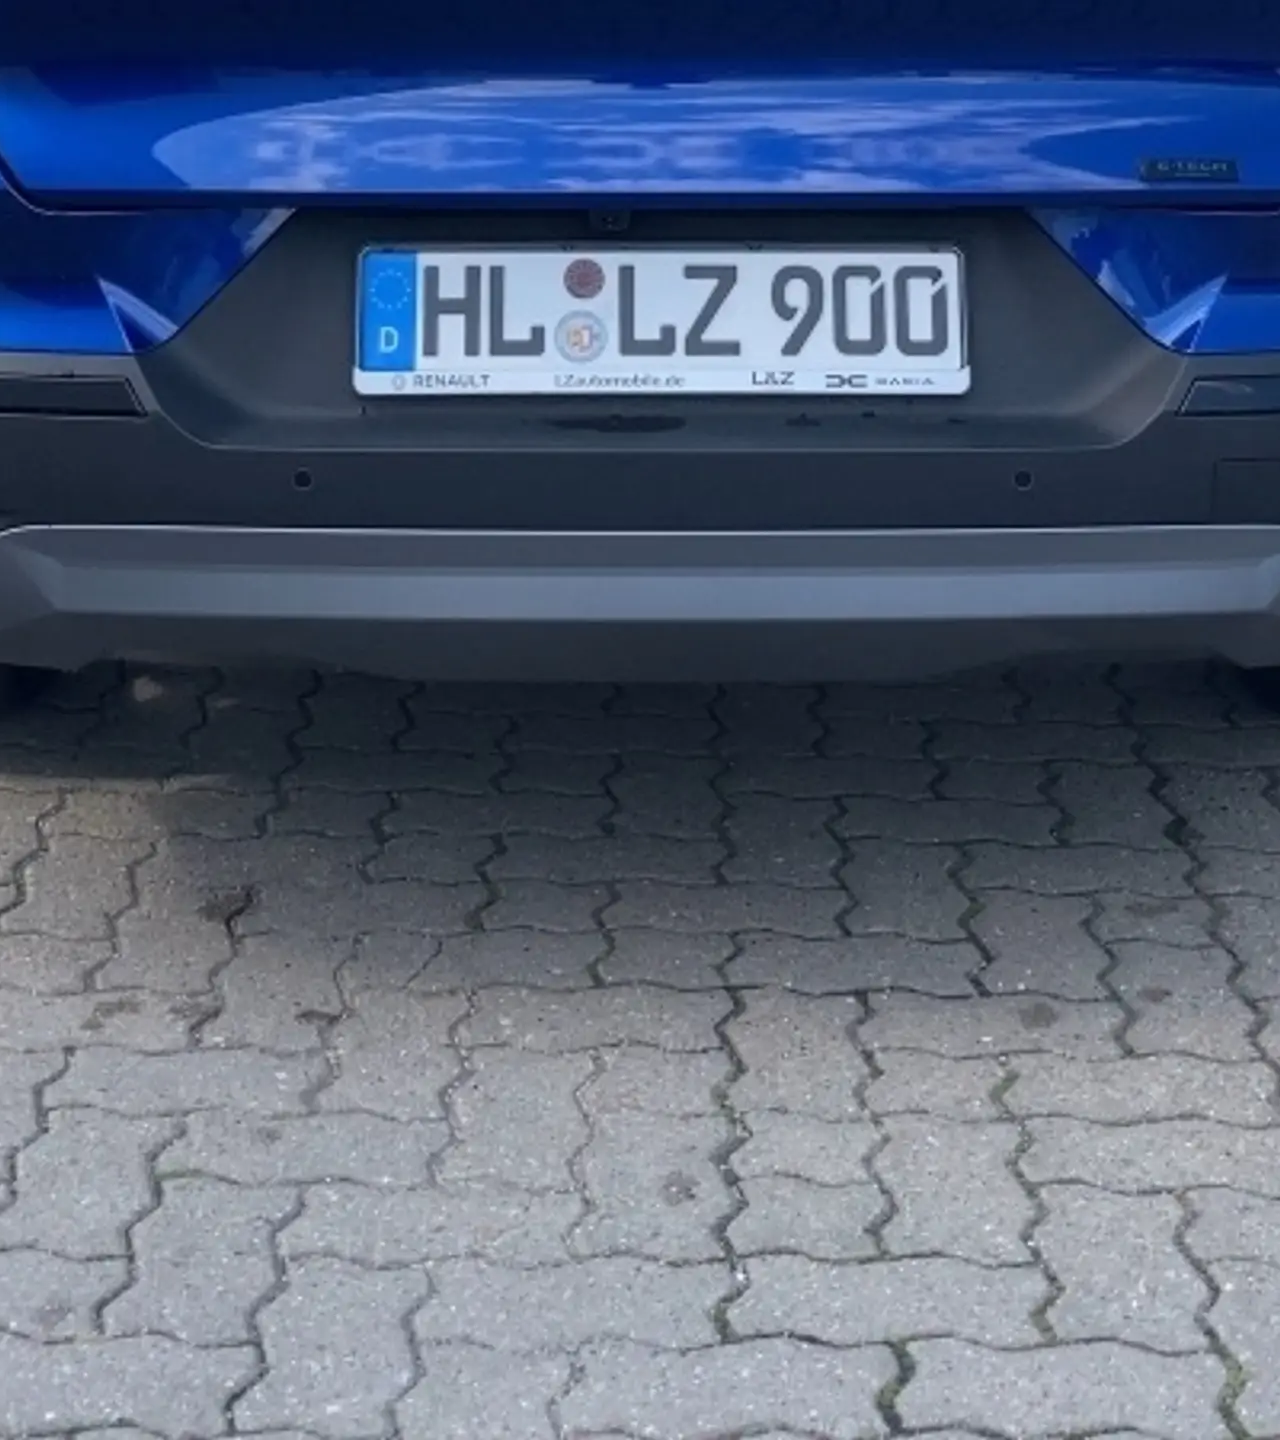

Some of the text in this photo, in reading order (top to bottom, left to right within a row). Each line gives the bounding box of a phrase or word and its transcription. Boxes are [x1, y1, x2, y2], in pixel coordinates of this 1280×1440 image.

[421, 263, 950, 357] HL LZ 900
[379, 325, 400, 354] D
[412, 374, 492, 389] RENAULT
